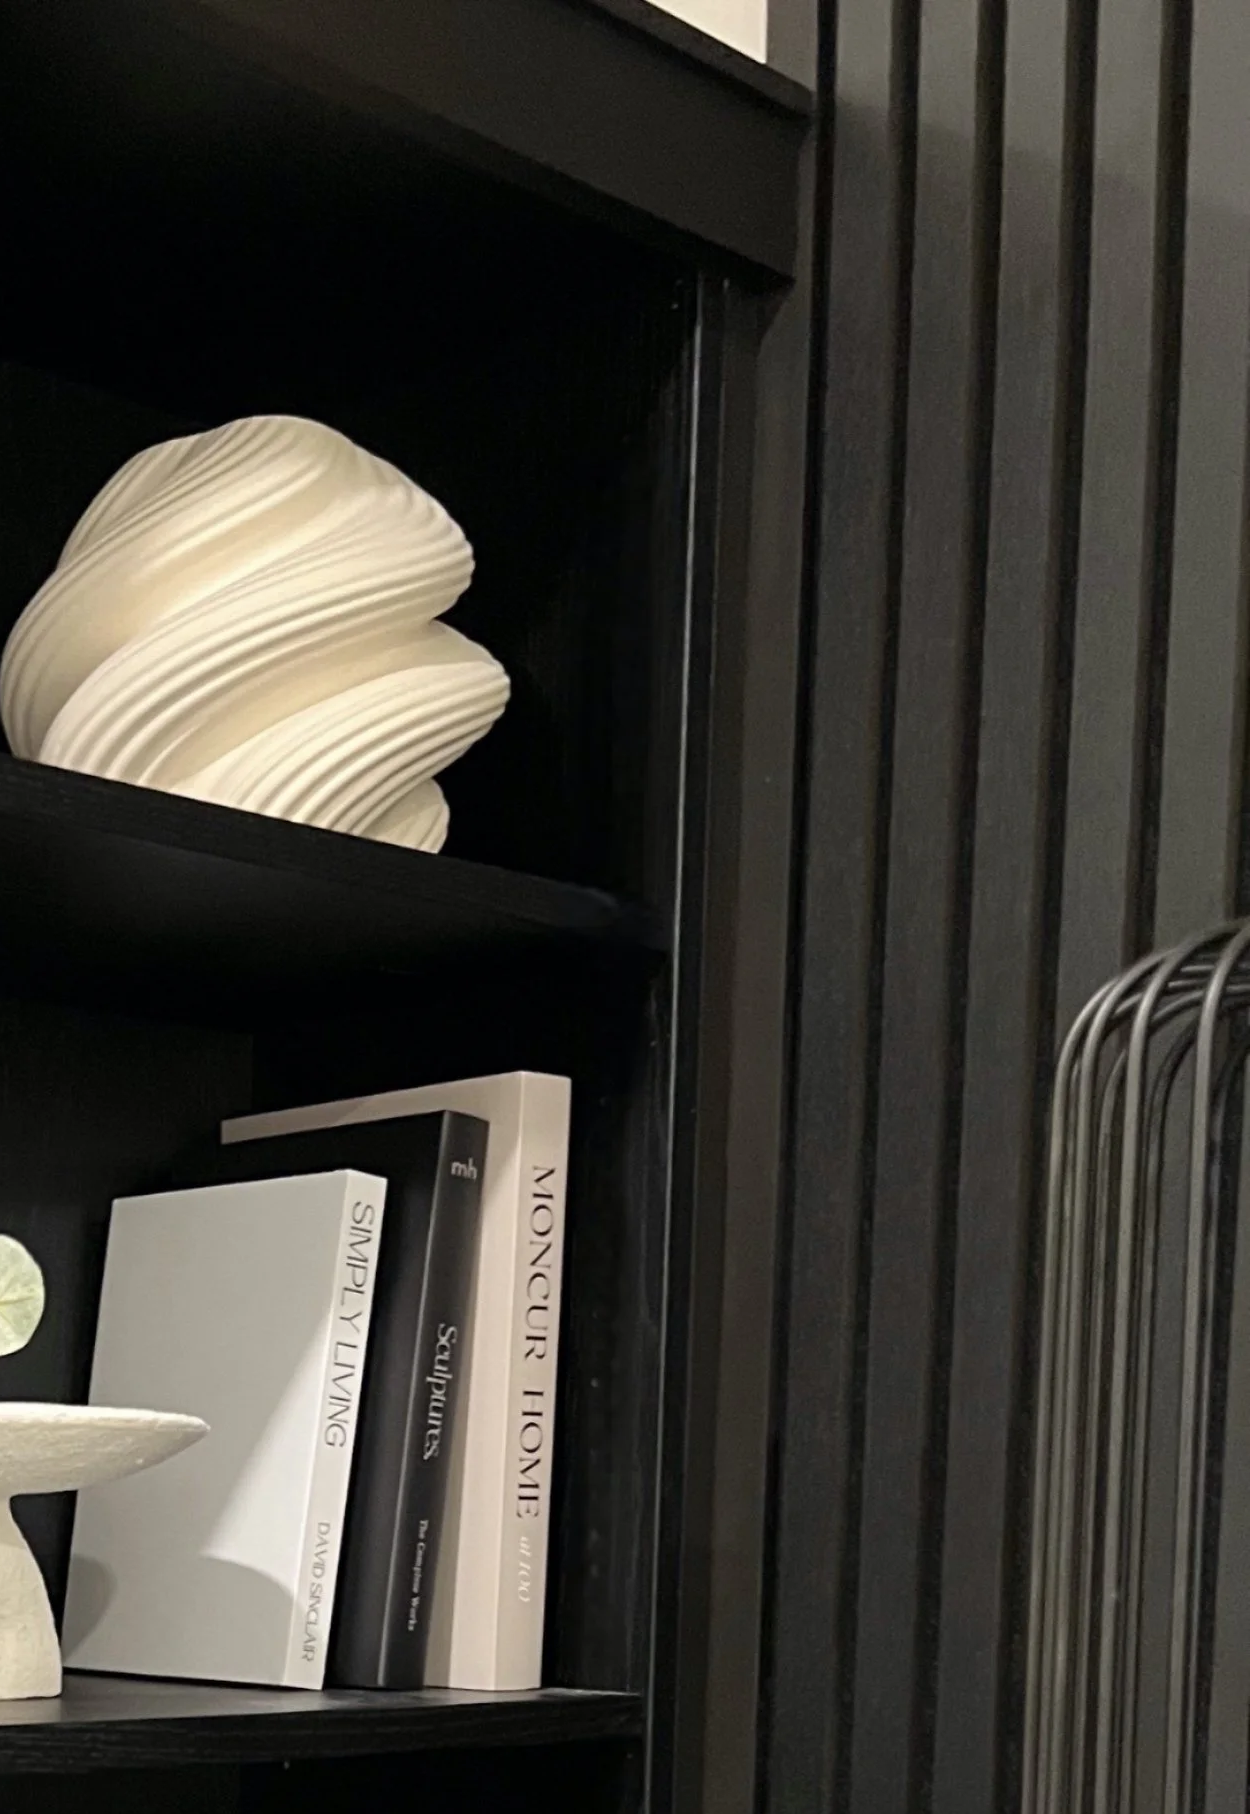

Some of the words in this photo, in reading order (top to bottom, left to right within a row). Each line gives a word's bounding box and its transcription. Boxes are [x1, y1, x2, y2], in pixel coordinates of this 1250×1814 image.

[450, 1158, 478, 1180] mh
[339, 1201, 376, 1335] SIMPLY
[524, 1165, 556, 1361] MONCUR
[324, 1340, 359, 1448] LIVING
[422, 1323, 457, 1460] Sculptures
[515, 1390, 545, 1519] HOME
[311, 1521, 331, 1579] DAVID
[418, 1519, 429, 1540] The
[301, 1582, 324, 1662] SINCLAIR
